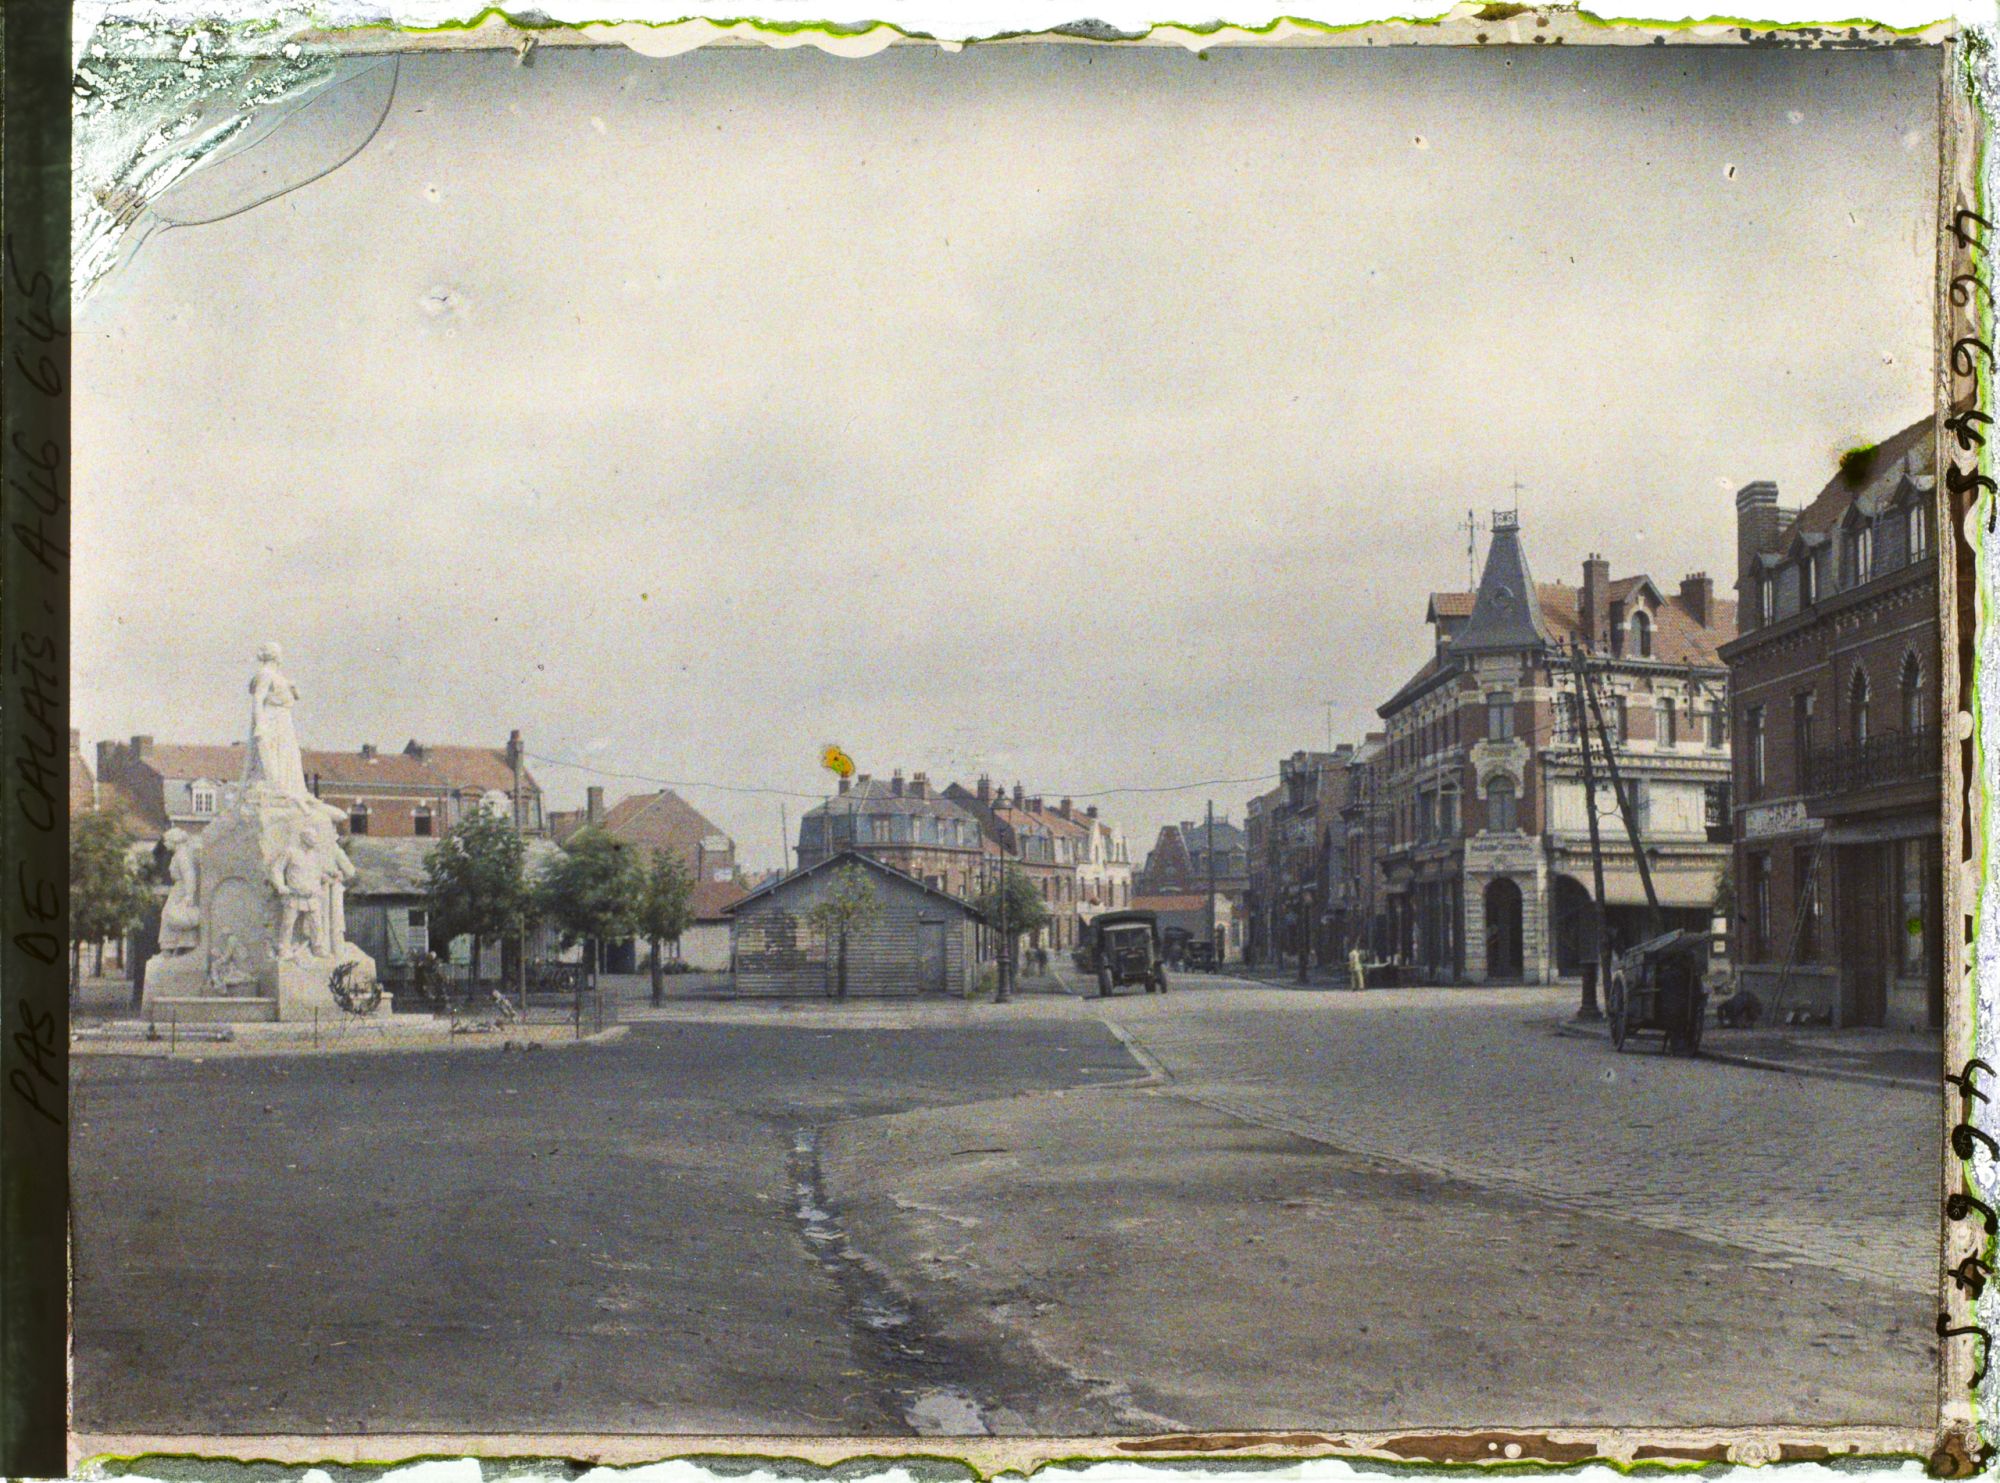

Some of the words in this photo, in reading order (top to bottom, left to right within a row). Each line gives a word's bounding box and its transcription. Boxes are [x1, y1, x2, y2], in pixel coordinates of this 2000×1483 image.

[7, 234, 66, 398] 645
[1945, 209, 1996, 534] 46645
[10, 432, 68, 575] A46
[14, 861, 60, 966] DE
[11, 998, 61, 1125] PAS
[1937, 1059, 1999, 1388] 46645
